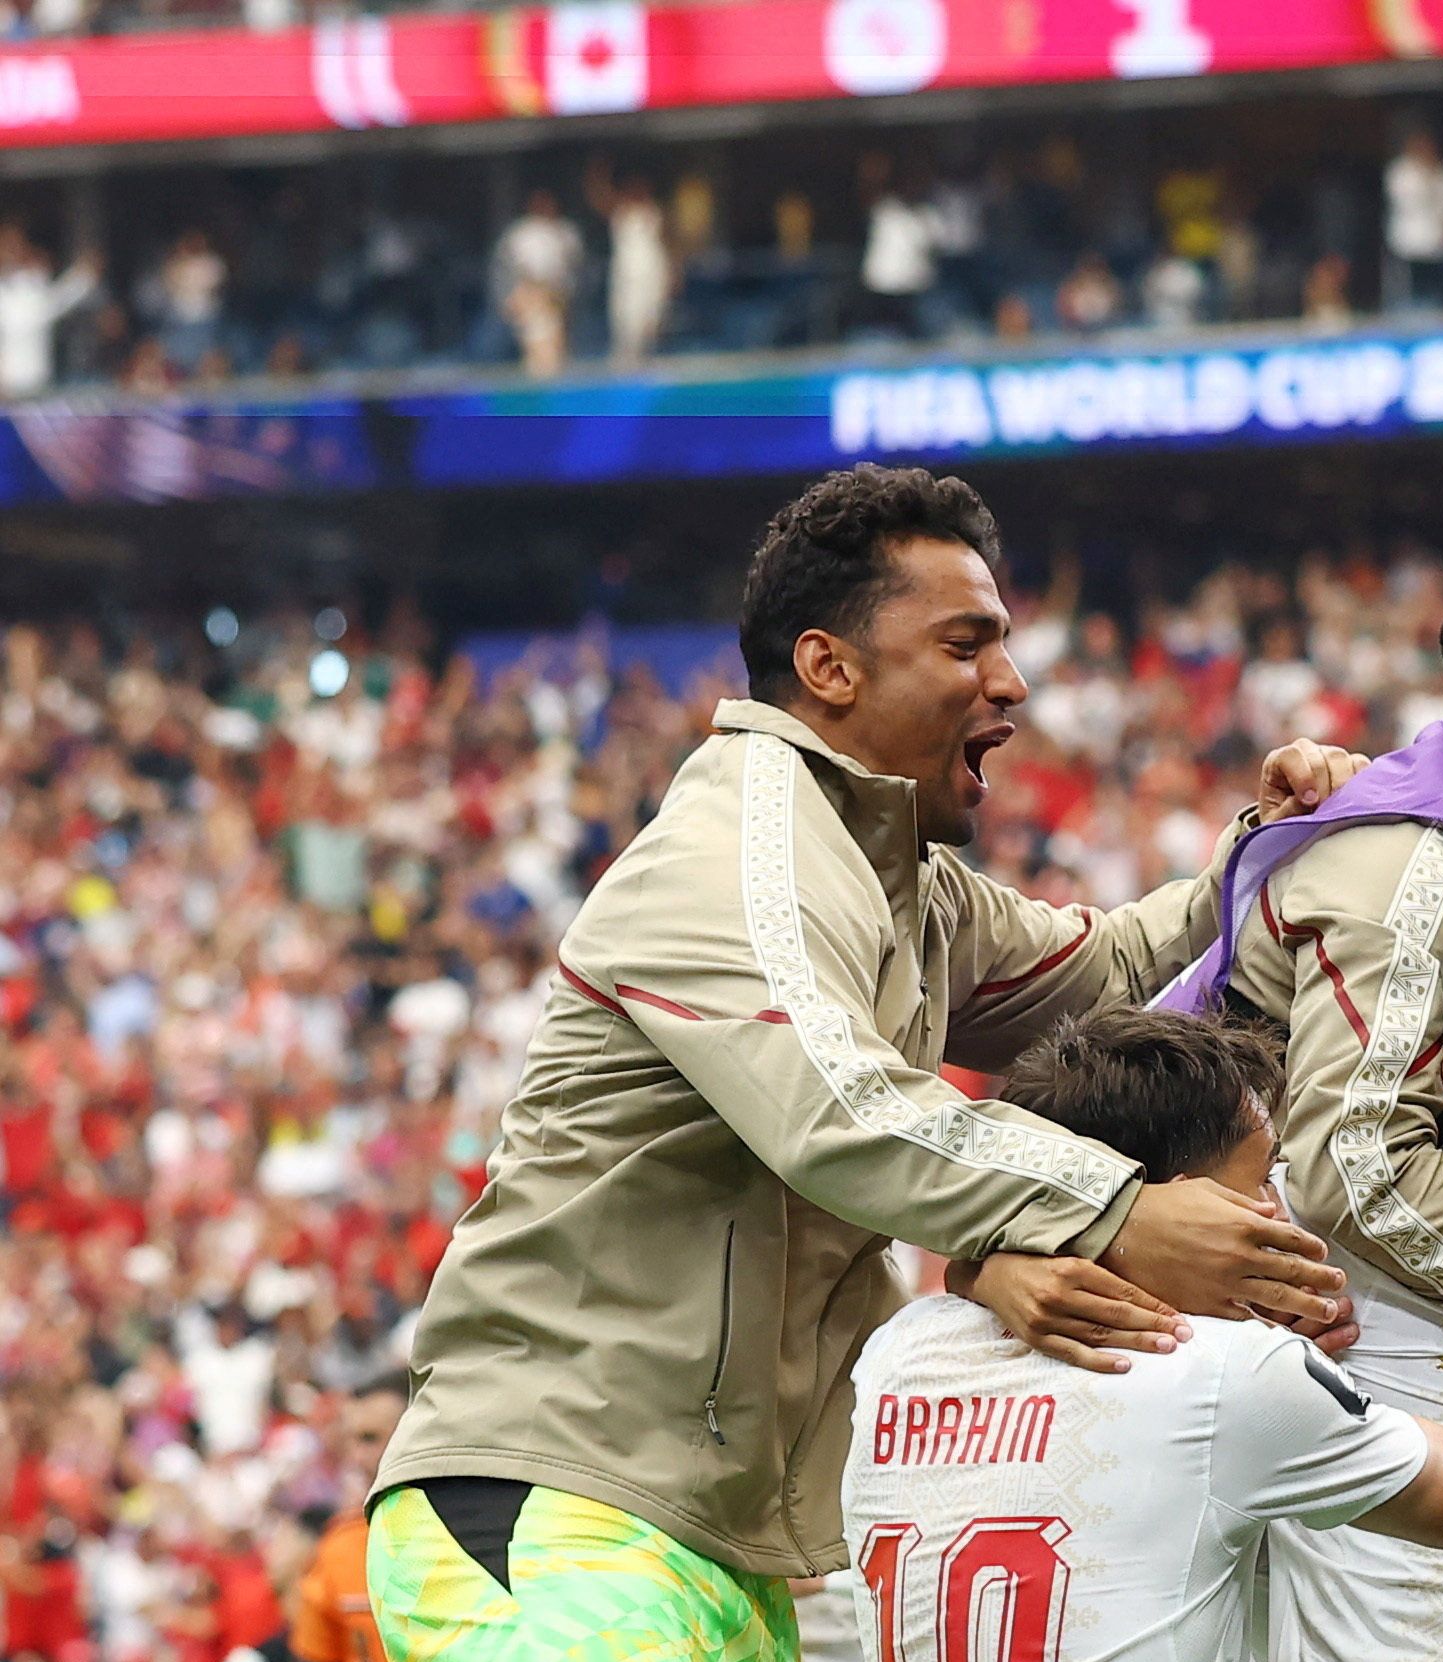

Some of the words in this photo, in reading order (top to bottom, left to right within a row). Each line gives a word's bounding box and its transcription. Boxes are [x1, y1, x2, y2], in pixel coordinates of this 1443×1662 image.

[832, 368, 991, 453] FIFA
[998, 355, 1252, 444] WORLD
[1255, 343, 1405, 430] CUP
[873, 1393, 1057, 1465] BRAHIM
